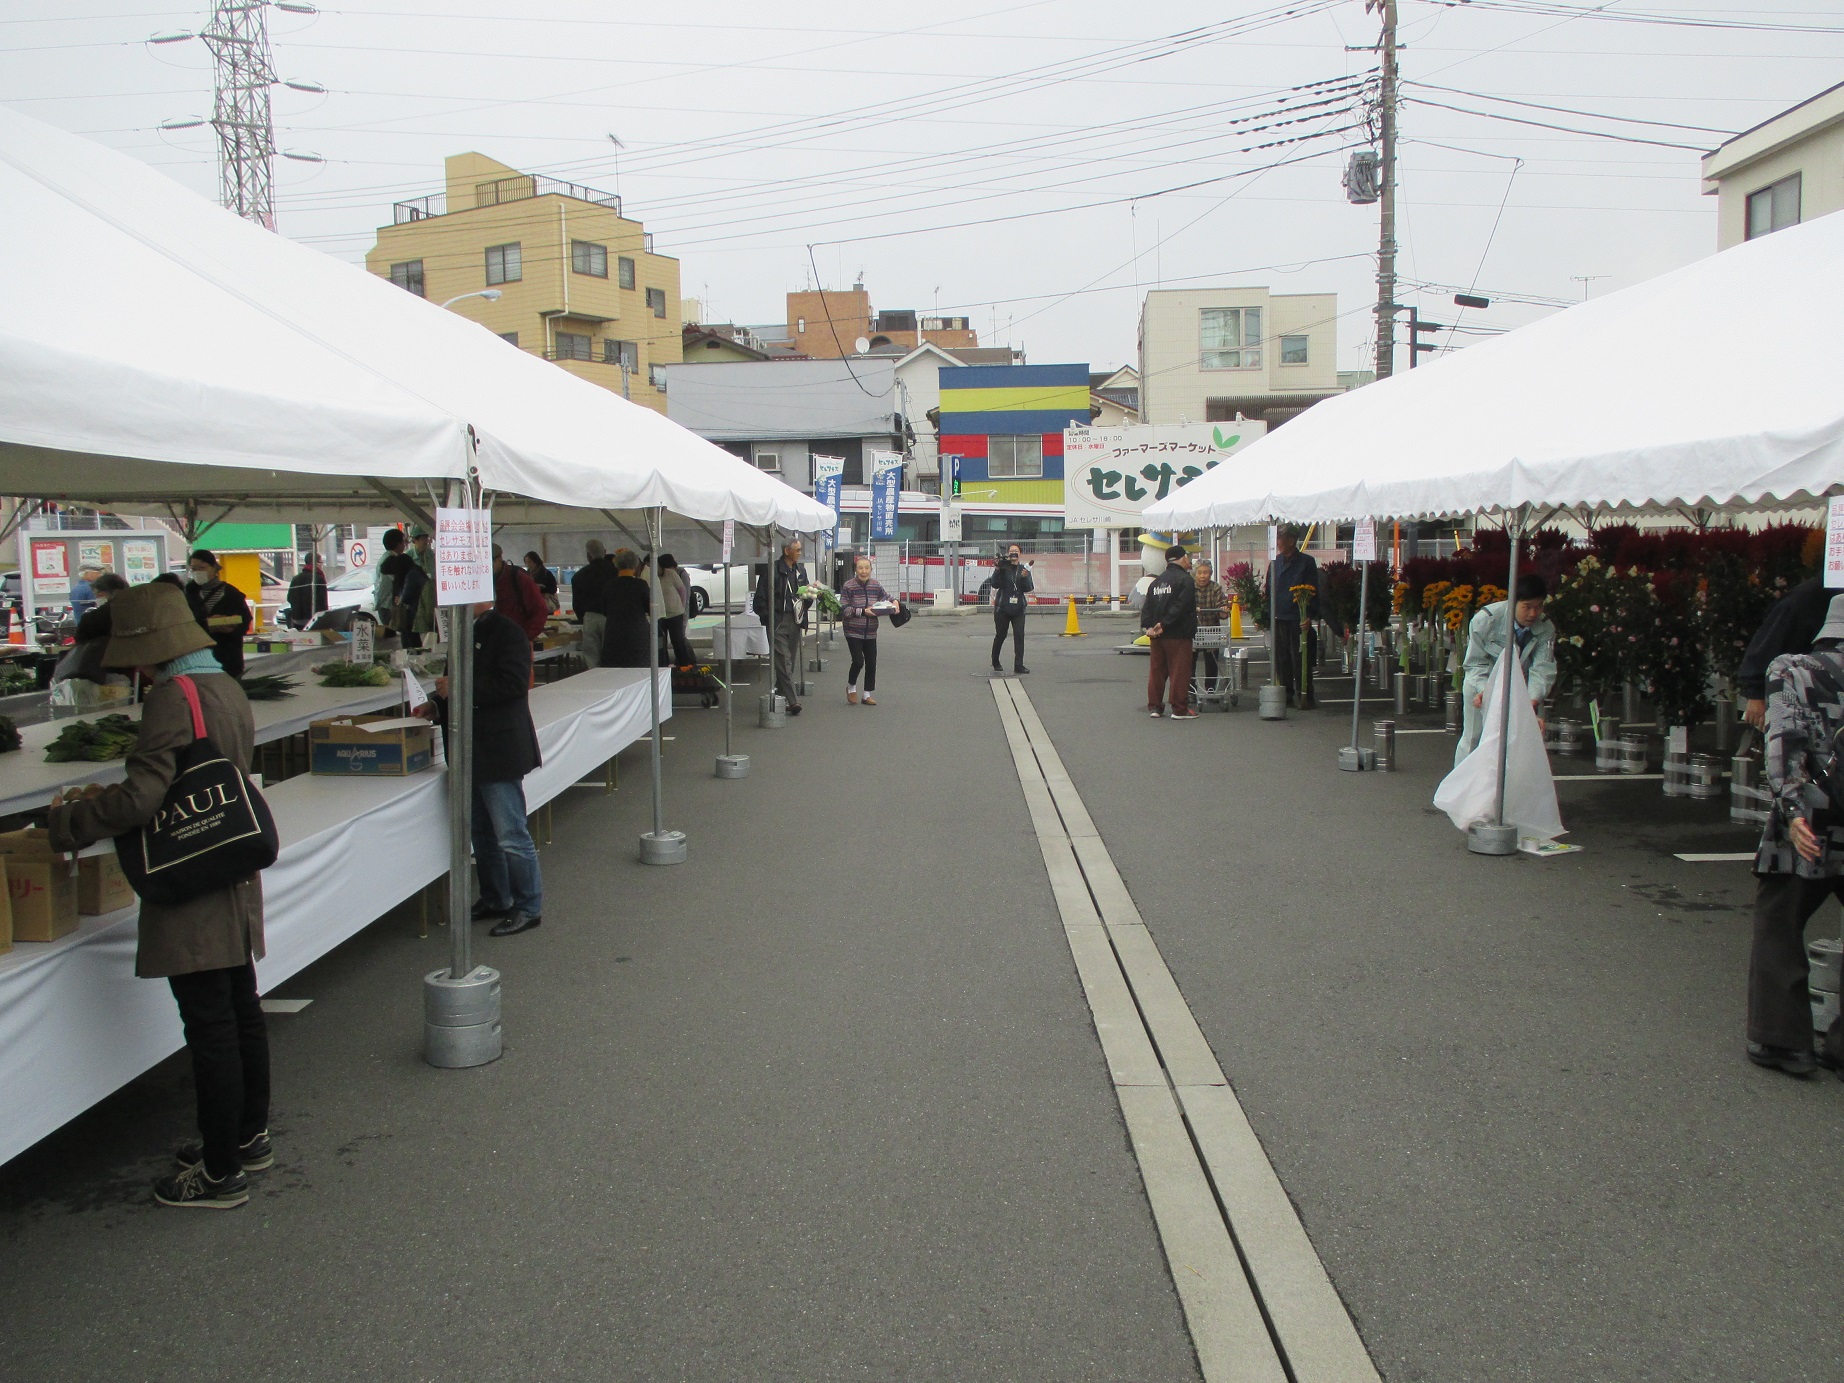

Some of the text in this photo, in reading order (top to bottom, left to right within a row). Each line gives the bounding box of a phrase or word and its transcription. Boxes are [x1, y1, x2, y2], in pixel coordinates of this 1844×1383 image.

[1112, 442, 1216, 458] ファーマーズマーケット
[954, 458, 960, 476] P
[1086, 460, 1220, 502] セレサ
[884, 472, 896, 536] 大型農産物直売所
[356, 624, 370, 652] 水菜
[336, 748, 377, 761] AQUARIUS
[153, 784, 238, 834] PAUL
